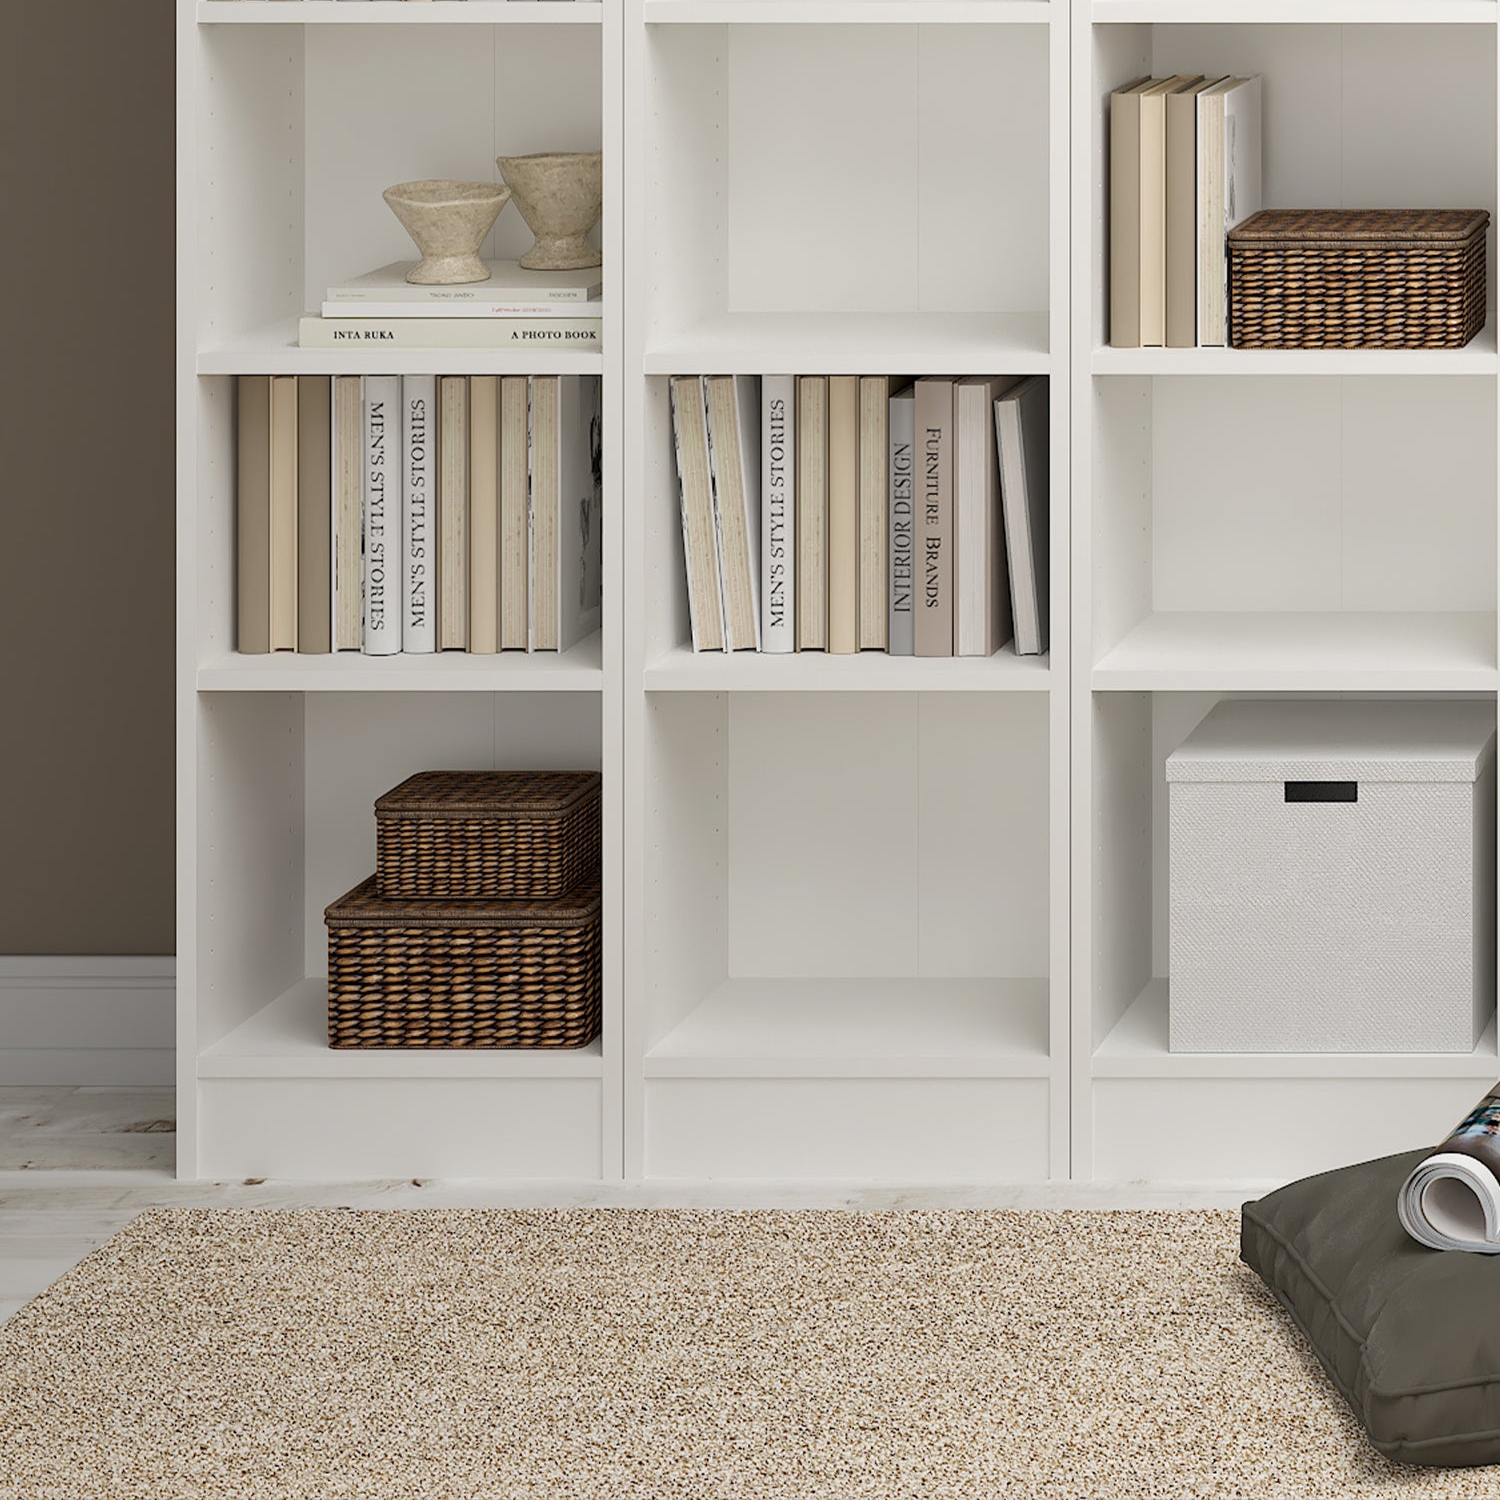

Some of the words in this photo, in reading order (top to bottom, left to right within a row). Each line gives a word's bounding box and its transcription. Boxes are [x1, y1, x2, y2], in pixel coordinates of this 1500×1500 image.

[334, 331, 361, 339] INTA
[364, 331, 395, 339] RUKA
[511, 331, 519, 339] A
[522, 331, 561, 339] PHOTO
[565, 331, 597, 339] BOOK
[370, 402, 384, 466] MEN'S
[411, 399, 425, 488] STORIES
[770, 399, 785, 488] STORIES
[370, 471, 384, 537] STYLE
[894, 443, 911, 515] DESIGN
[926, 427, 941, 525] FURNITURE
[411, 492, 425, 559] STYLE
[770, 492, 785, 559] STYLE
[370, 543, 384, 631] STORIES
[411, 563, 425, 628] MEN'S
[770, 563, 785, 628] MEN'S
[894, 520, 911, 612] INTERIOR
[926, 537, 941, 608] BRANDS
